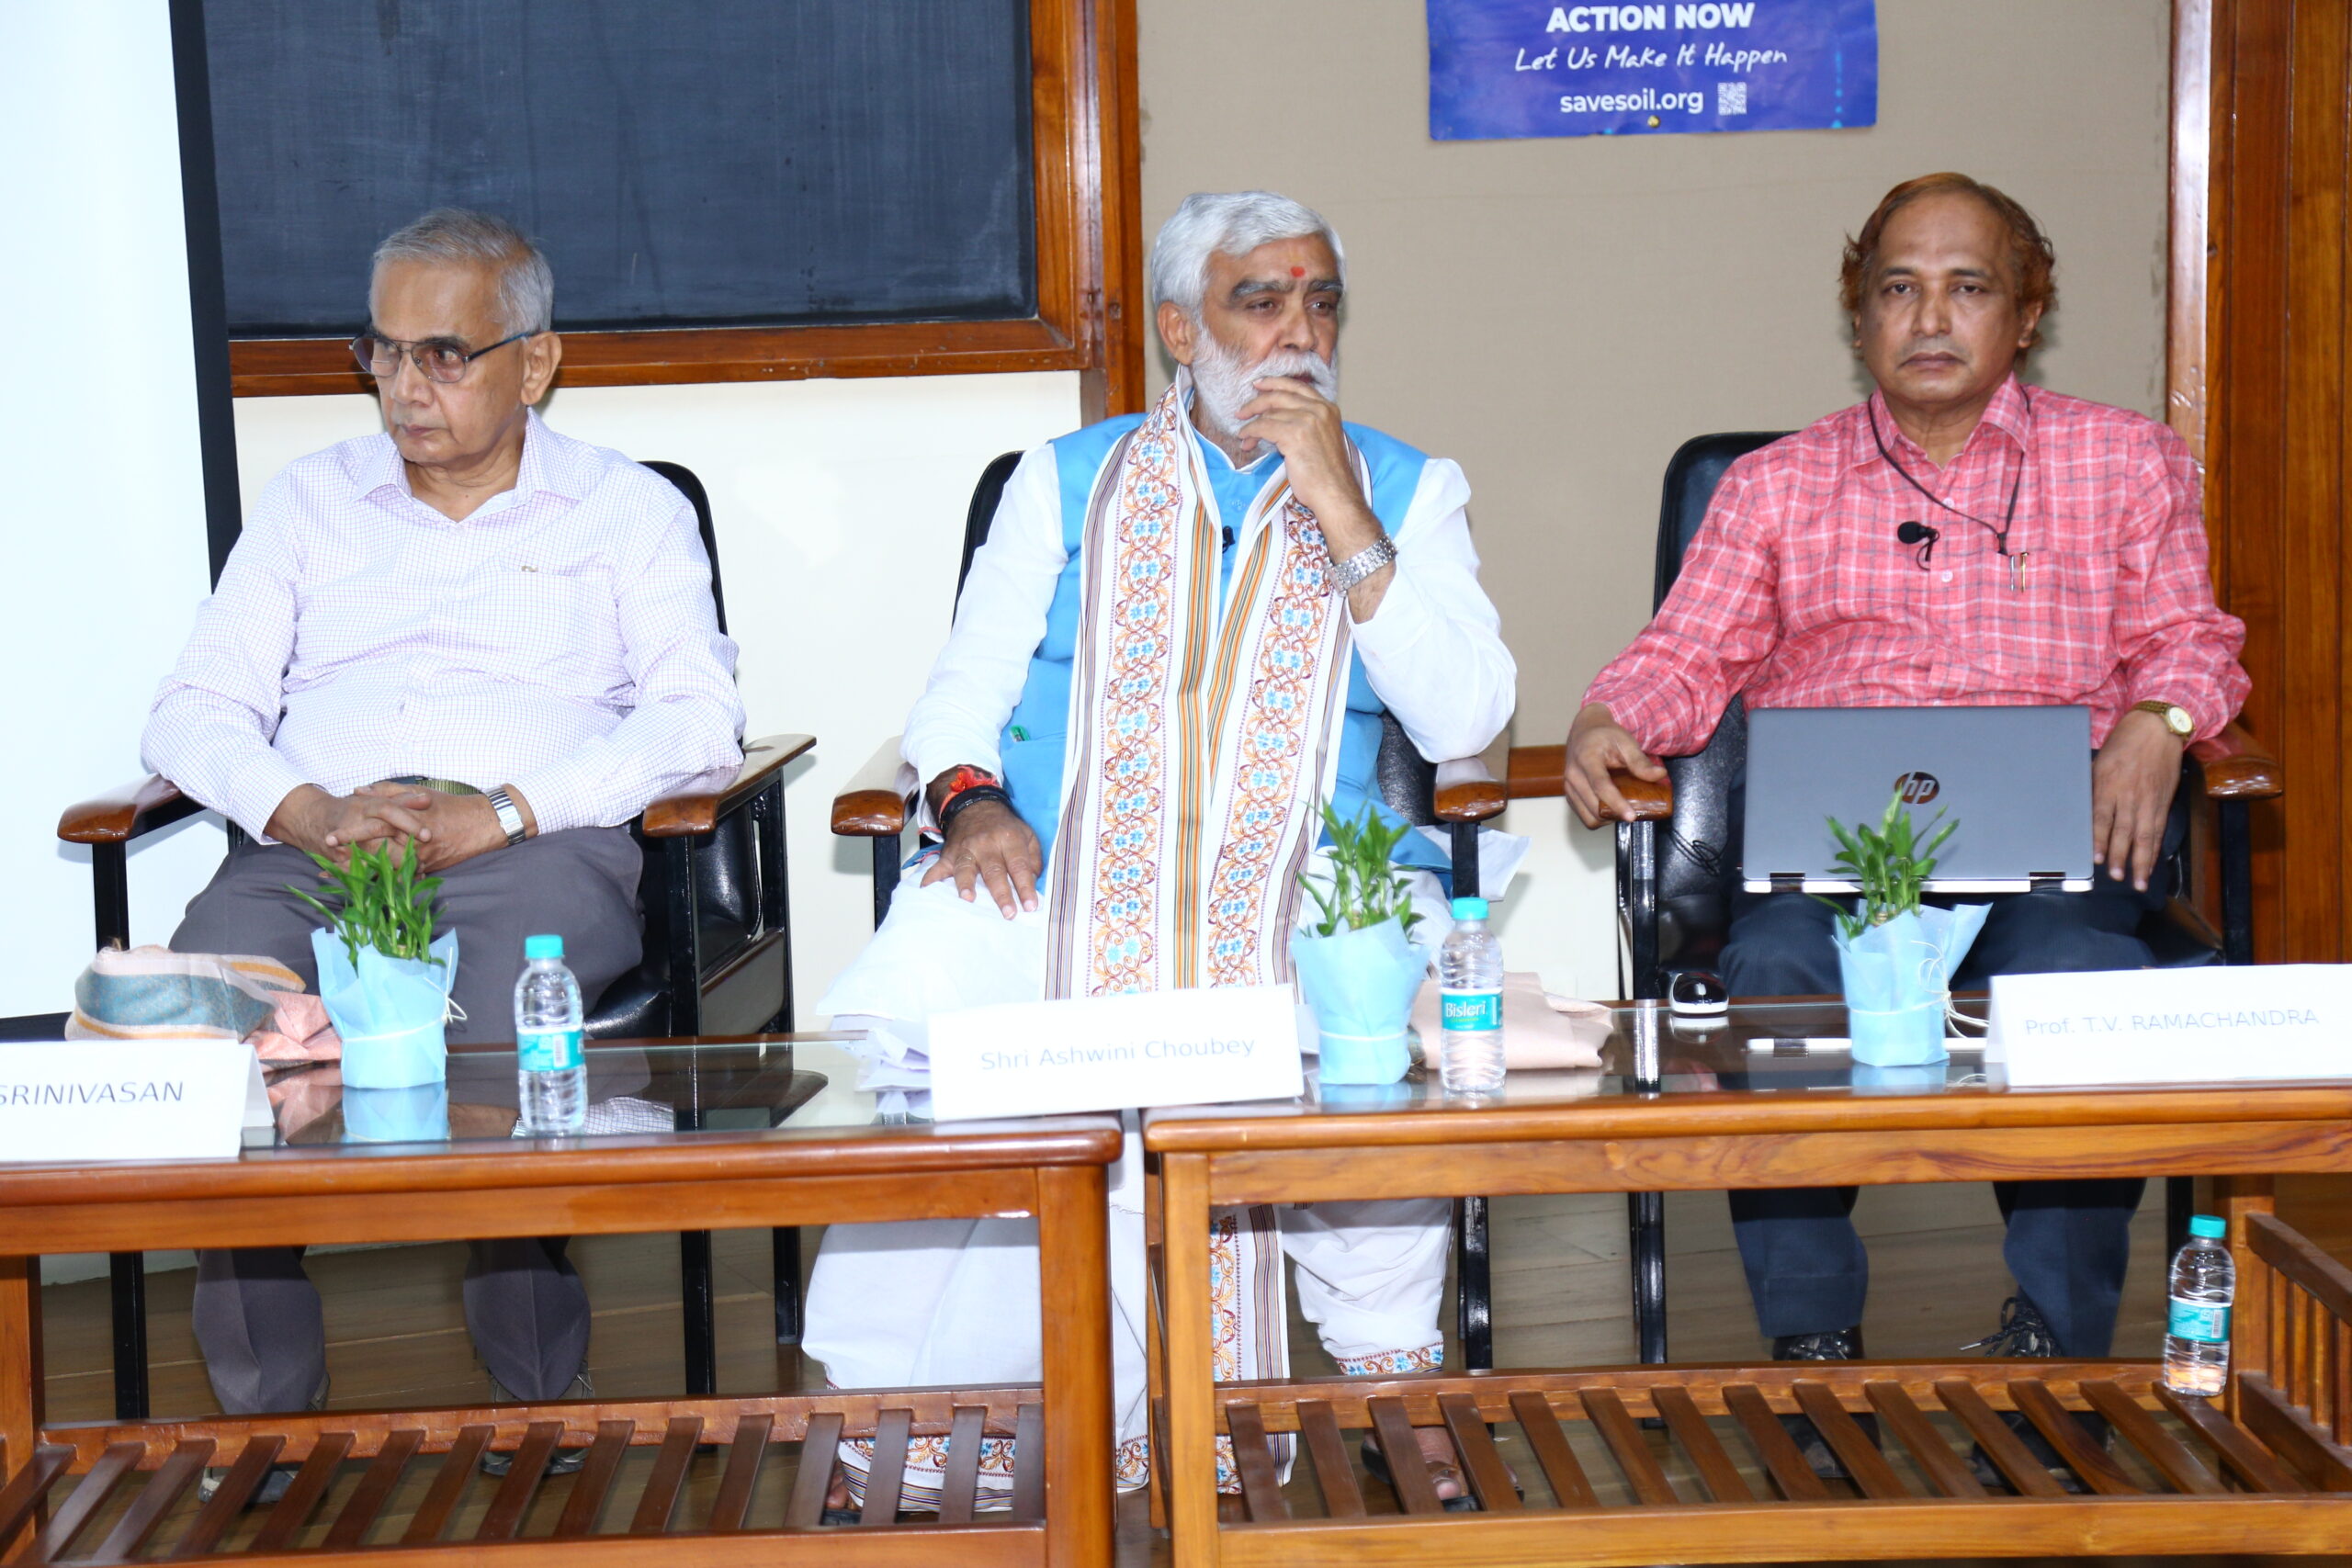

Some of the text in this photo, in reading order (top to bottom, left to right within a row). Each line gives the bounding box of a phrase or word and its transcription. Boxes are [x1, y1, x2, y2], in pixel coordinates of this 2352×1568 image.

[1546, 2, 1755, 32] ACTION NOW
[1515, 42, 1788, 73] Let Us Make It Happen
[1560, 88, 1703, 114] savesoil.org
[1902, 772, 1936, 804] hp
[1445, 999, 1487, 1018] Bisleri
[2025, 1009, 2320, 1036] Prof. T.V. RAMACHANDRA
[980, 1037, 1255, 1070] Shri Ashwini Choubey
